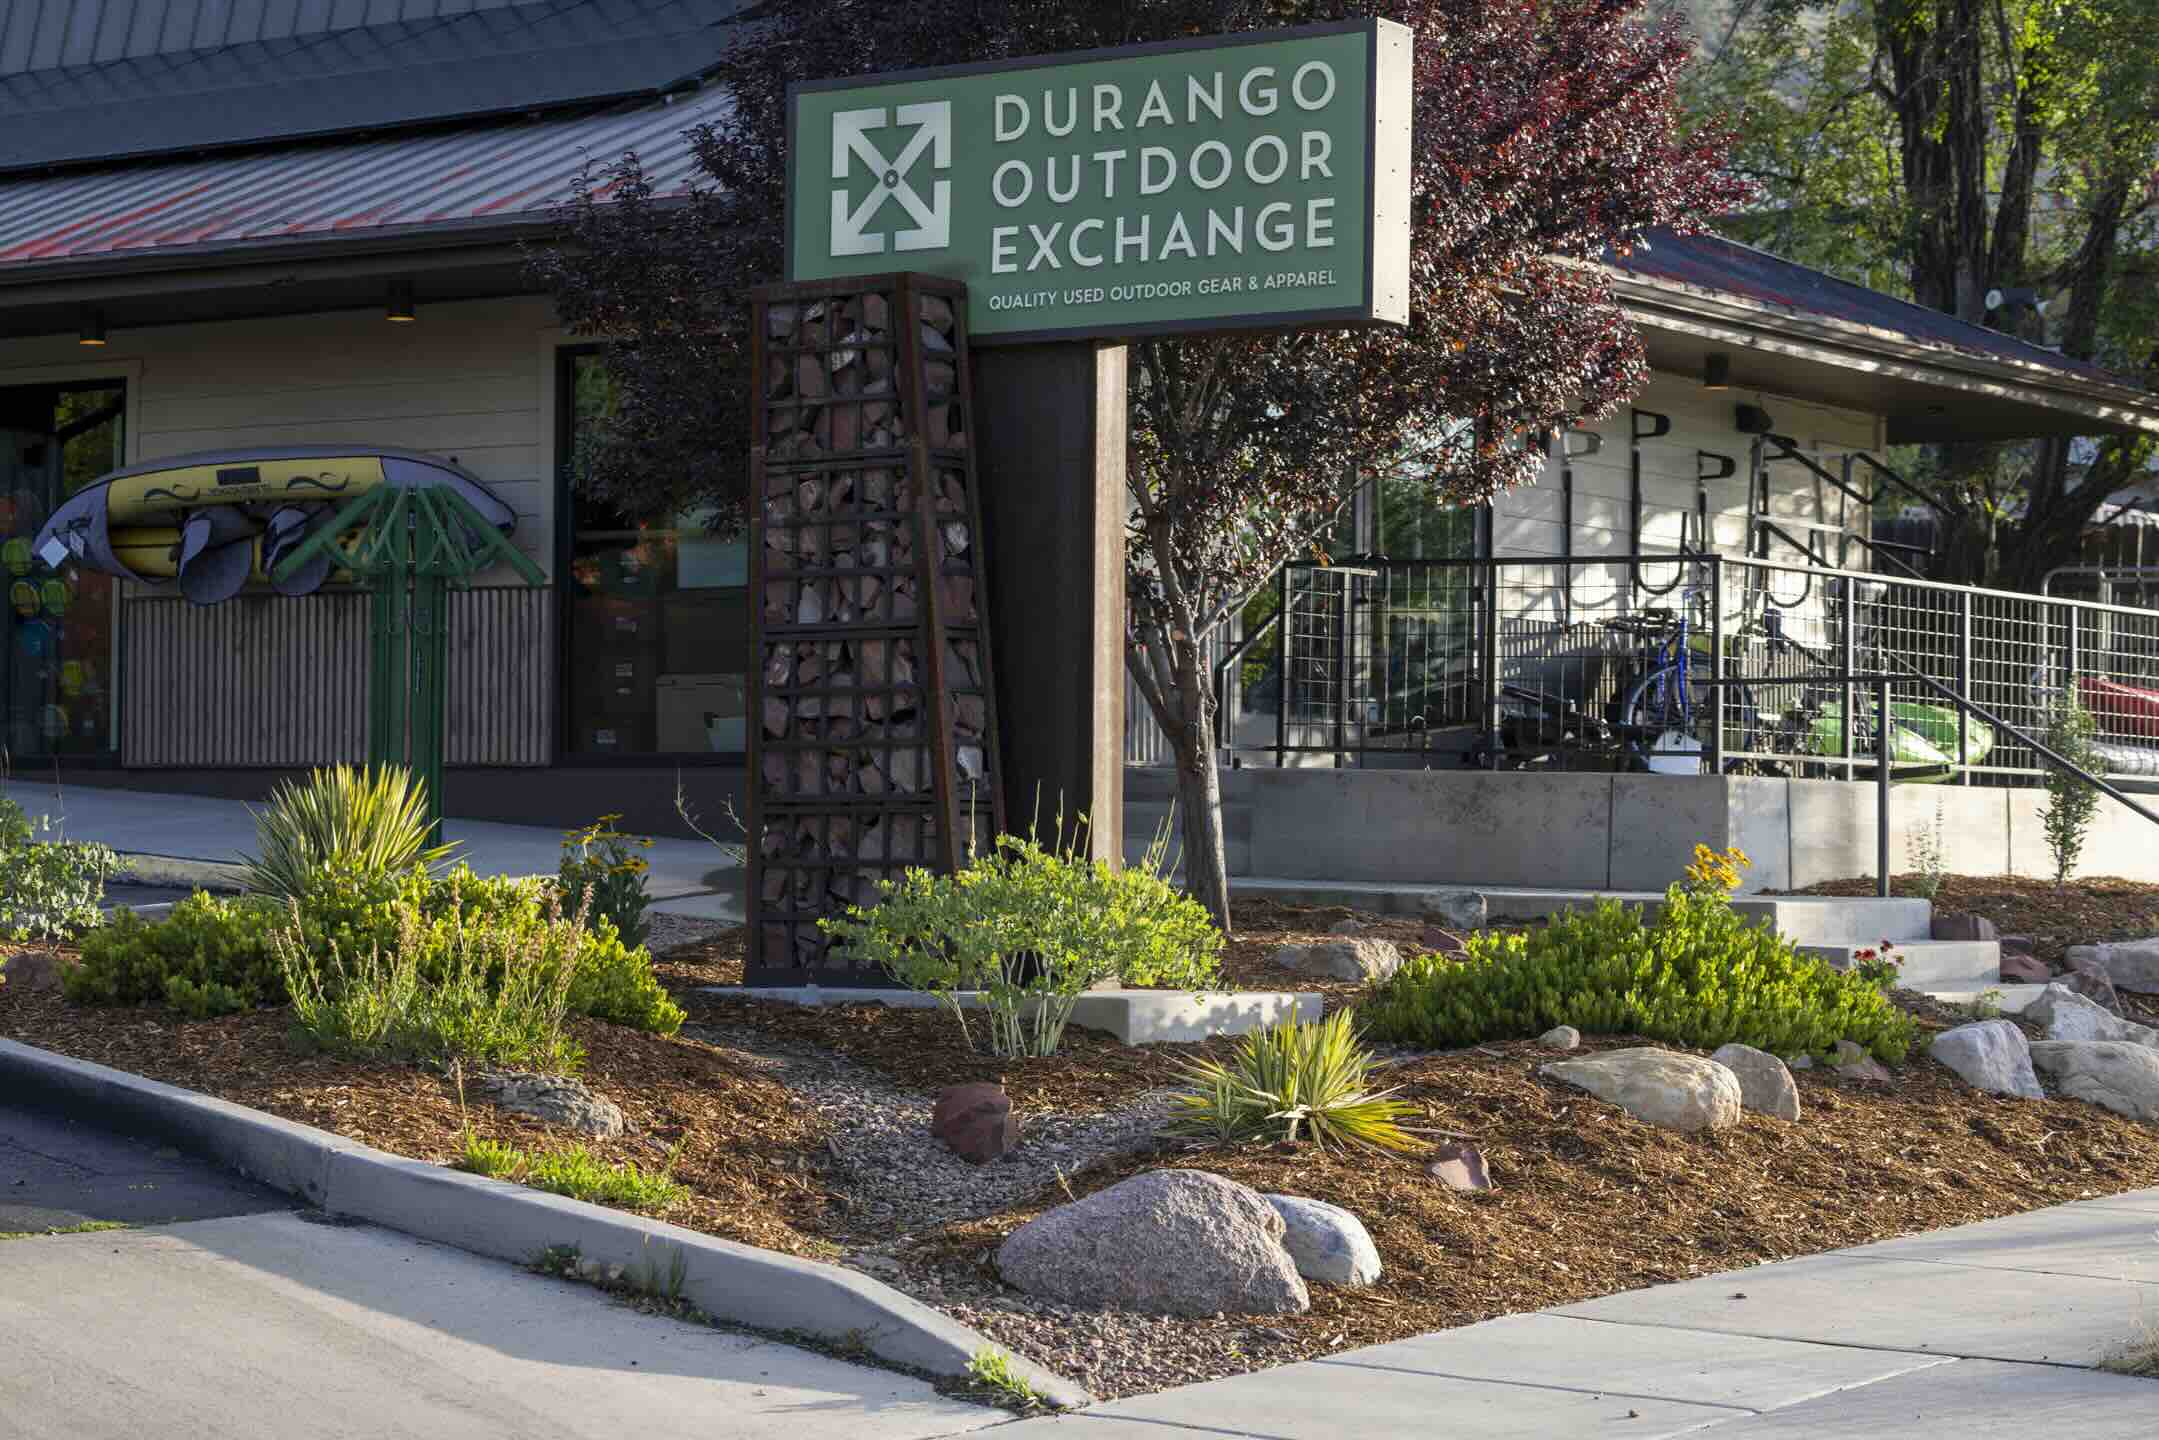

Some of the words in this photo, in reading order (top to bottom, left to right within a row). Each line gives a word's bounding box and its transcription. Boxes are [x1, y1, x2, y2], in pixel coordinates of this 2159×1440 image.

[994, 60, 1337, 142] DURANGO
[991, 130, 1334, 208] OUTDOOR
[990, 198, 1336, 274] EXCHANGE
[989, 290, 1057, 311] QUALITY
[1063, 287, 1105, 305] USED
[1110, 281, 1192, 301] OUTDOOR
[1198, 278, 1242, 294] GEAR
[1247, 275, 1259, 291] &
[1263, 270, 1337, 290] APPAREL
